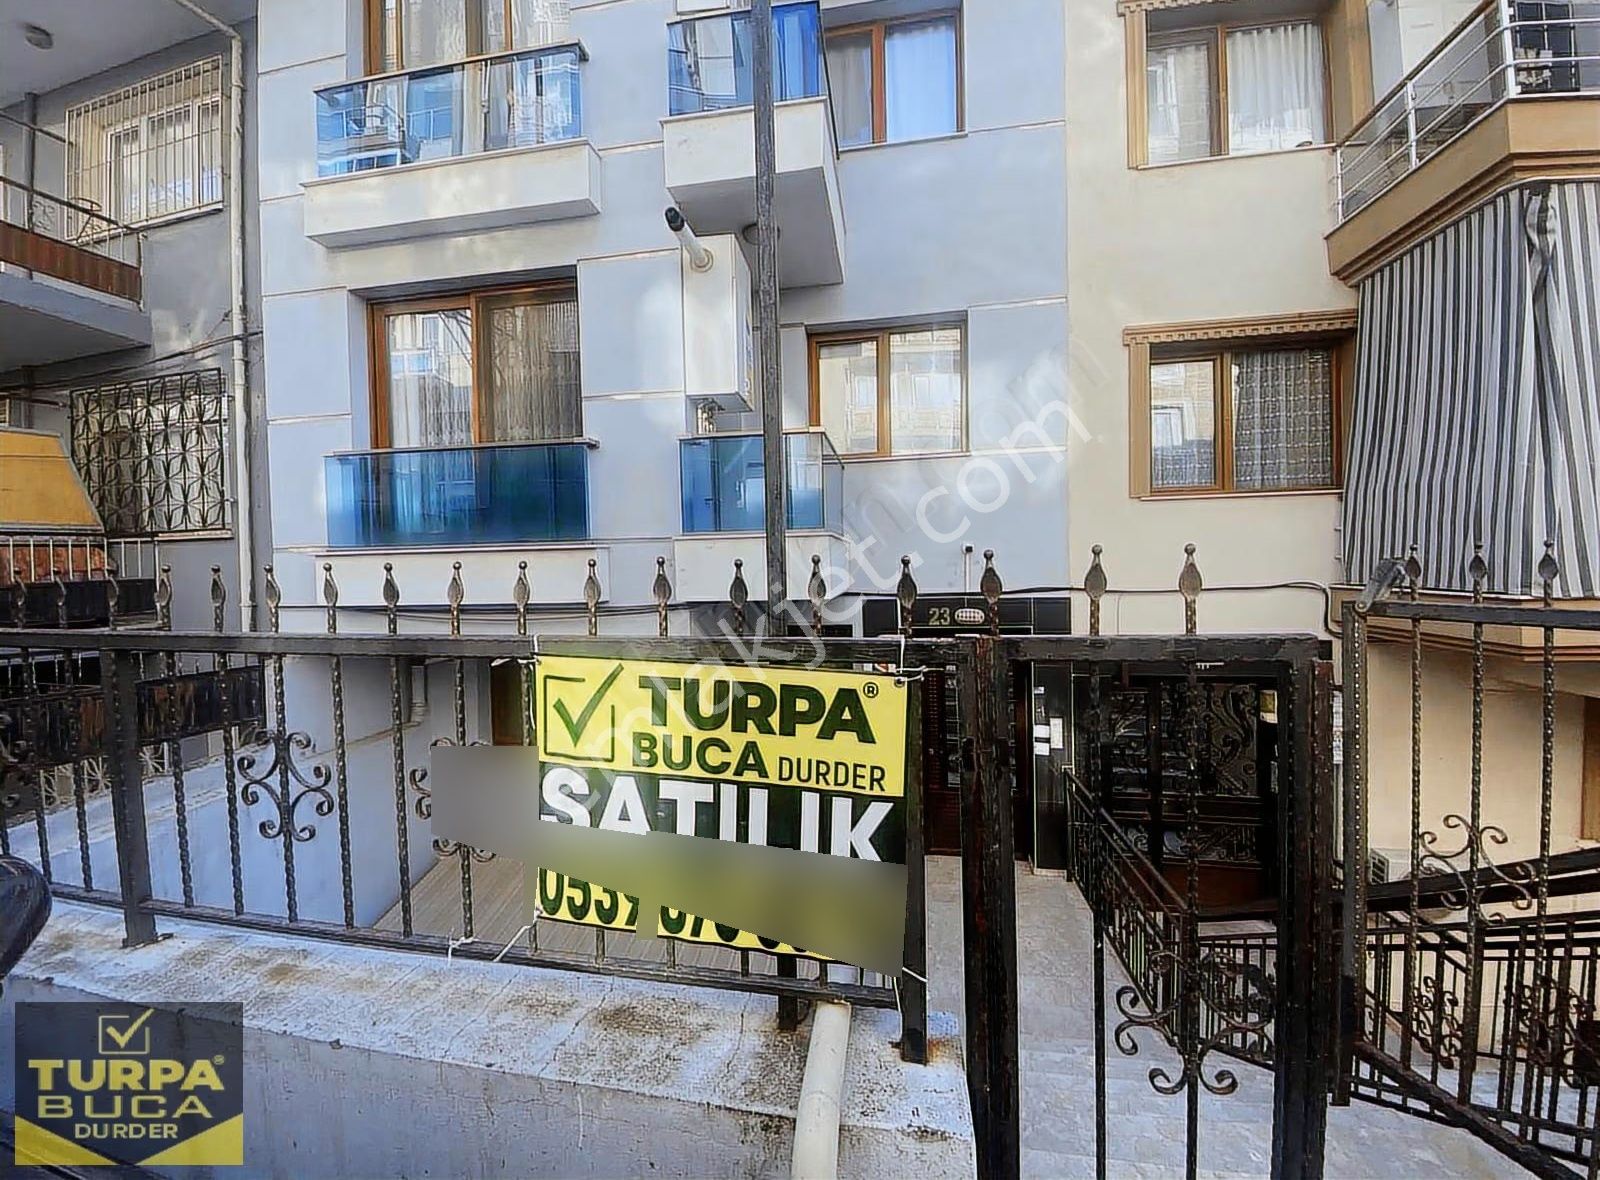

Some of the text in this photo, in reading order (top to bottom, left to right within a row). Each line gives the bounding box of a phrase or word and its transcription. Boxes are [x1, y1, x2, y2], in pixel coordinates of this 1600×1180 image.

[928, 607, 950, 626] 23
[632, 731, 886, 792] BUCA DURDER
